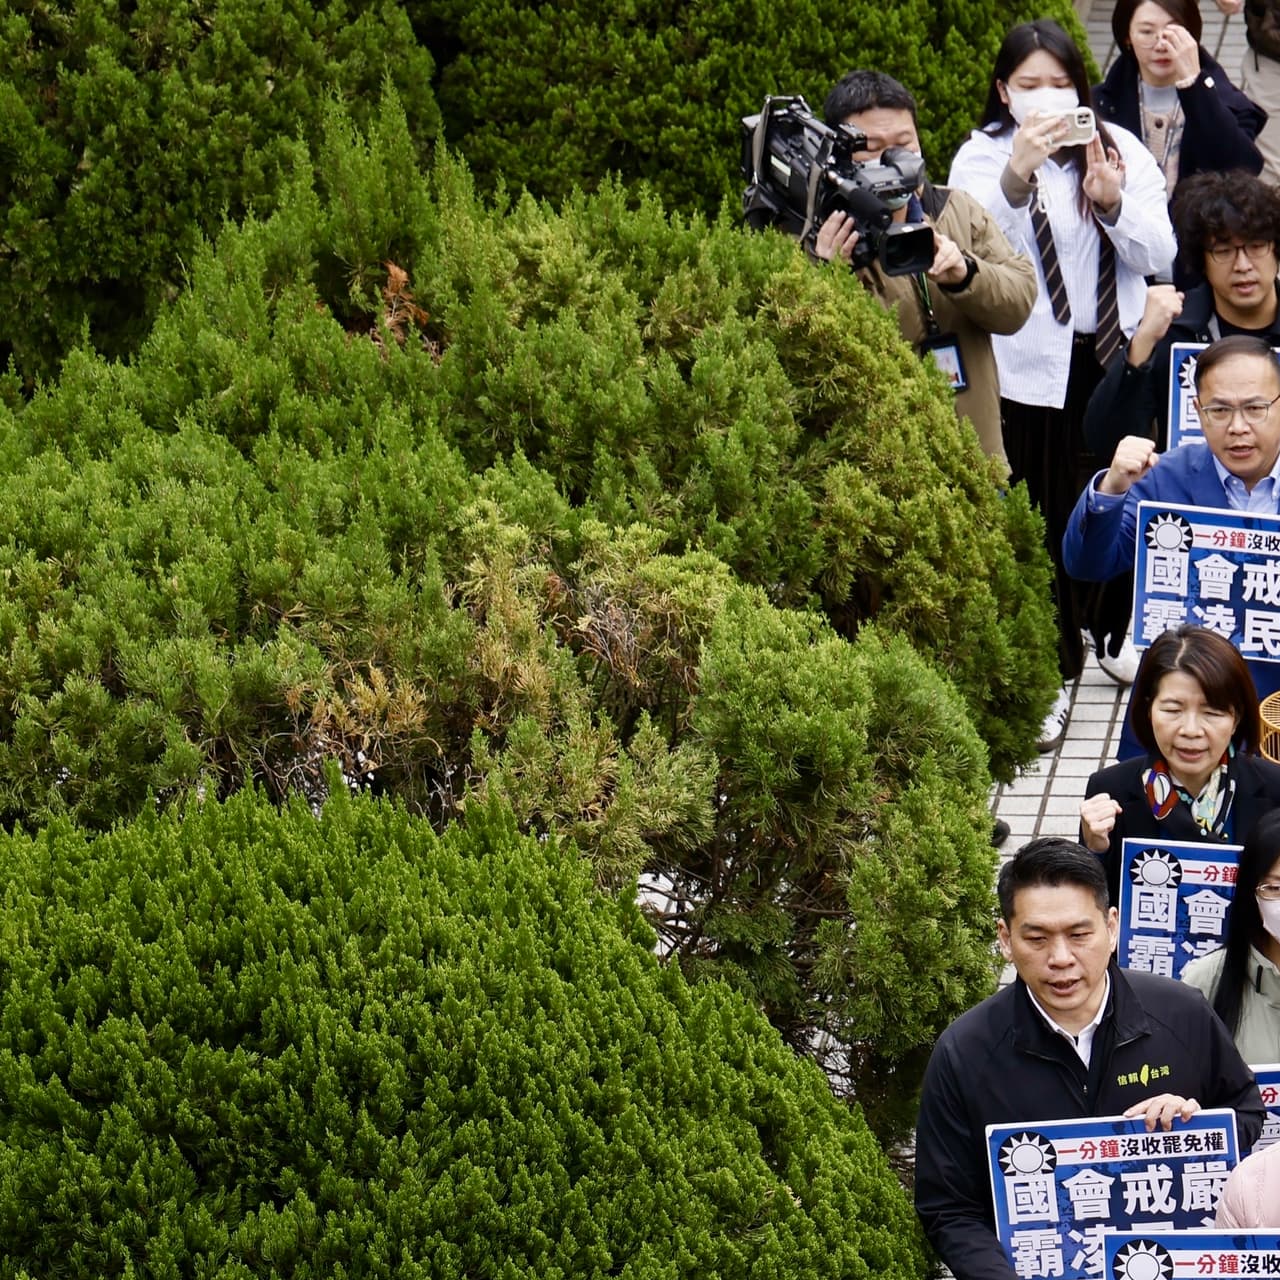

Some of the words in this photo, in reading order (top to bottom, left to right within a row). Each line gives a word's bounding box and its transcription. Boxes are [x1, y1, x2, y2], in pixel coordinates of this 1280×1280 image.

[1130, 885, 1231, 936] 國會
[1058, 1132, 1226, 1162] 一分鐘沒收罷免權
[1005, 1161, 1228, 1225] 國會戒嚴
